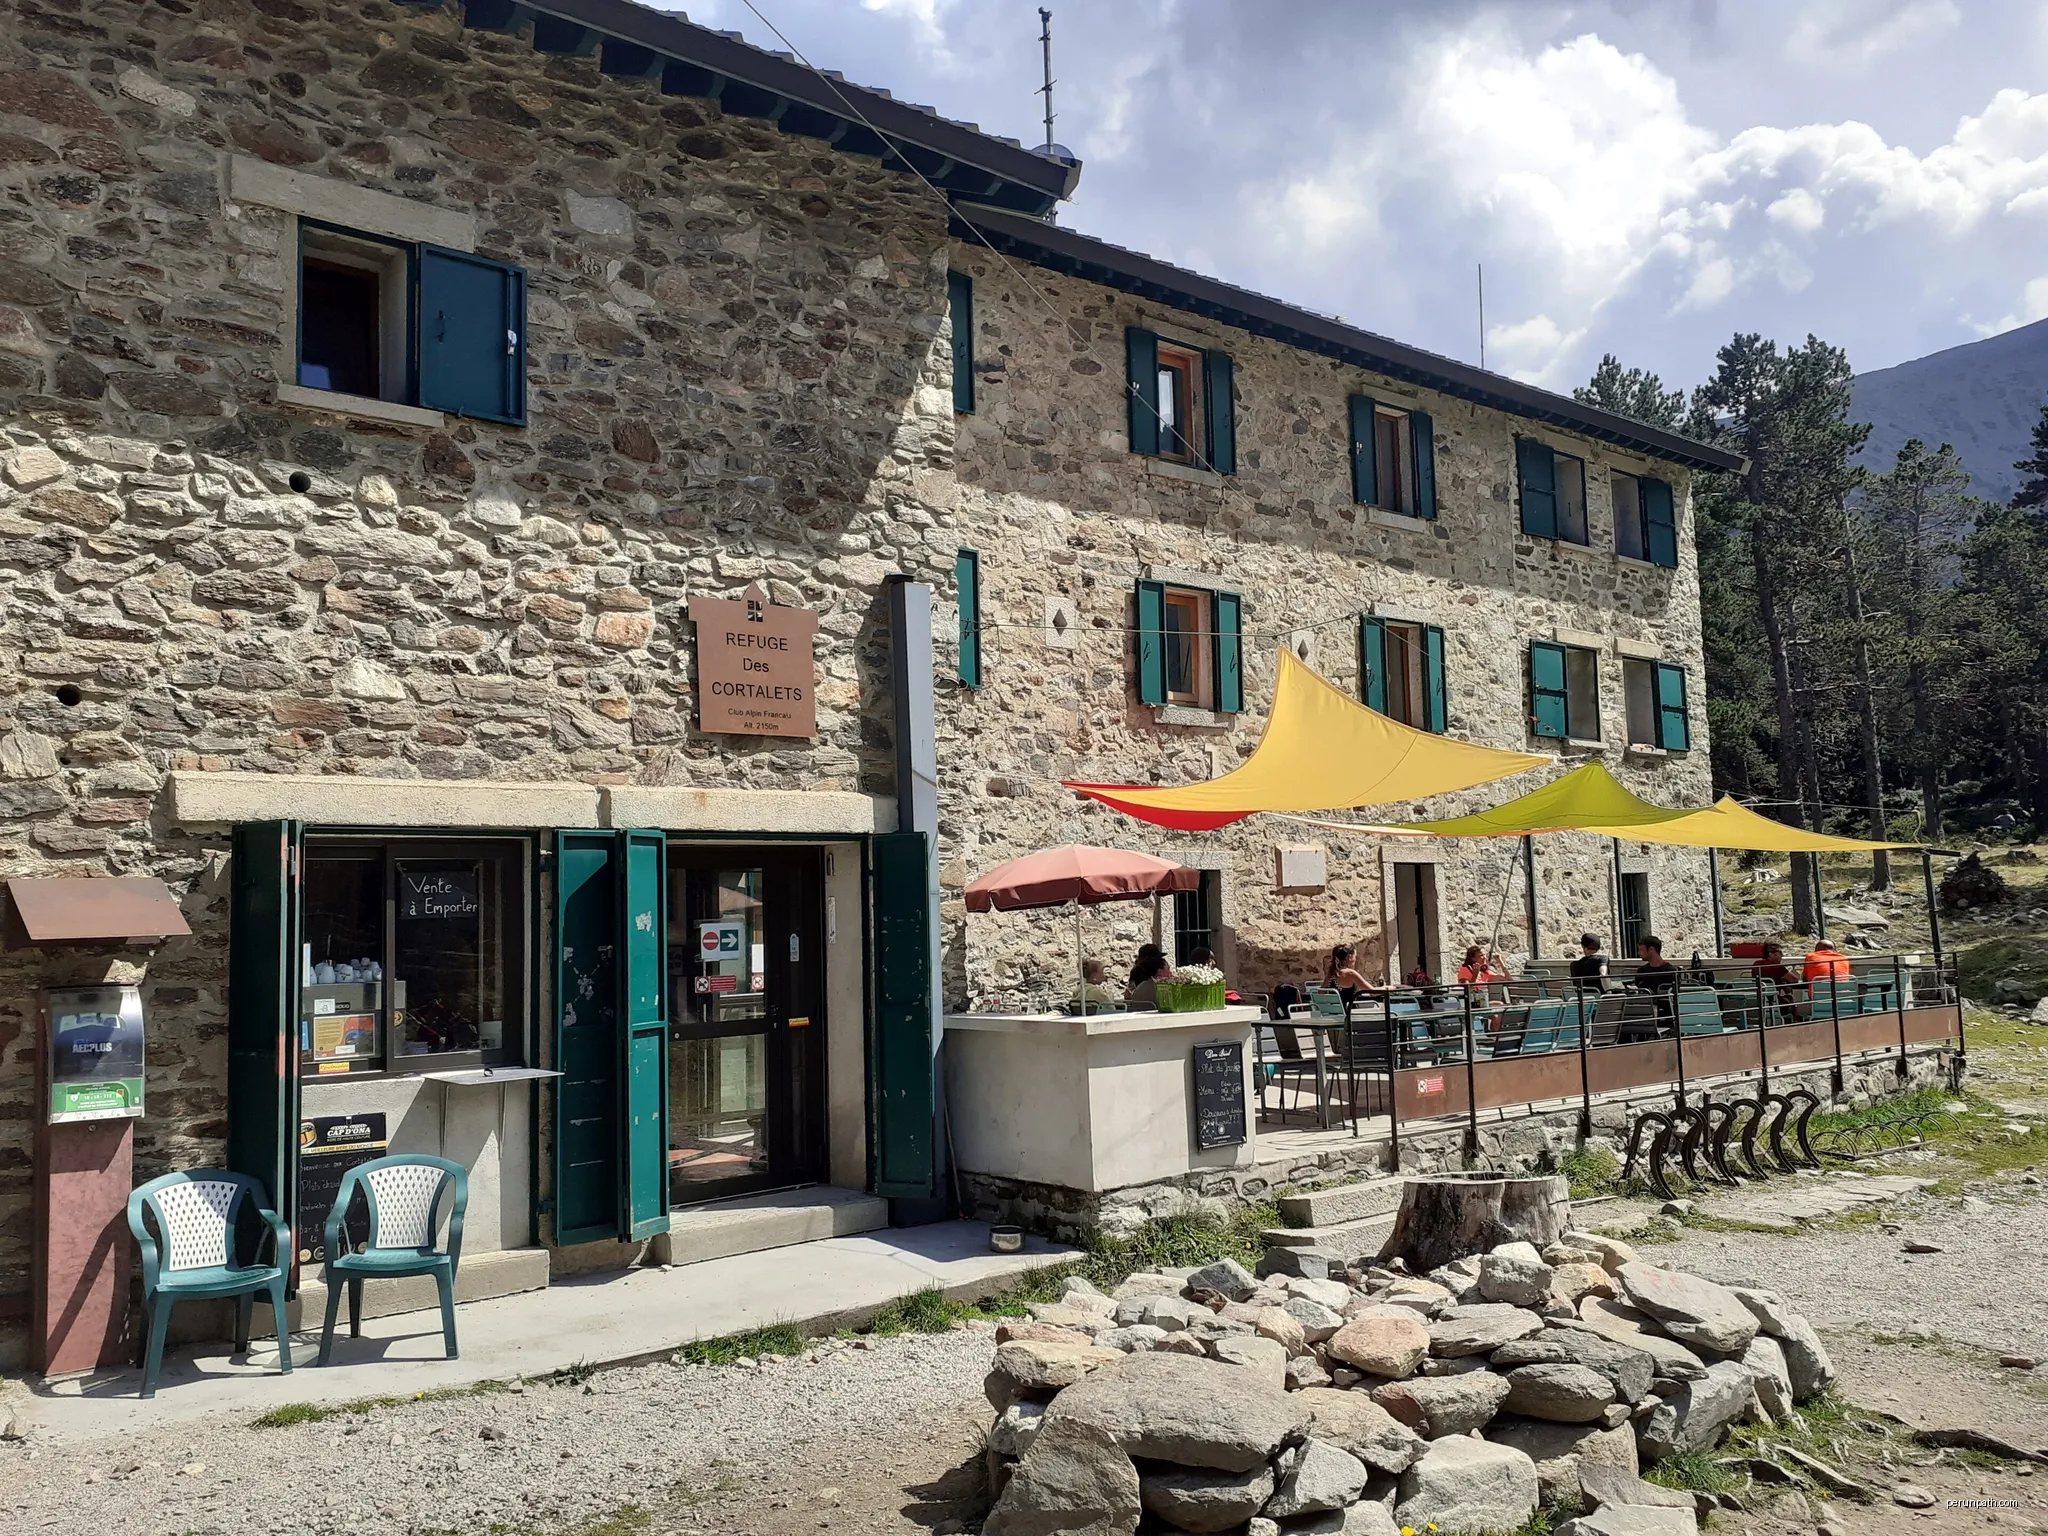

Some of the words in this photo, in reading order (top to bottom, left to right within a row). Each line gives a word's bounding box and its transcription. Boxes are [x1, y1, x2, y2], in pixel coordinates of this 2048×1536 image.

[726, 632, 789, 651] REFUGE
[743, 657, 769, 672] Des
[711, 681, 802, 701] CORTALETS
[728, 708, 744, 717] Club
[745, 709, 762, 719] Alpin
[408, 876, 452, 893] Vente
[409, 901, 417, 916] à
[425, 896, 478, 918] Emporter
[327, 1128, 344, 1137] CAP
[345, 1126, 371, 1135] D'ONA
